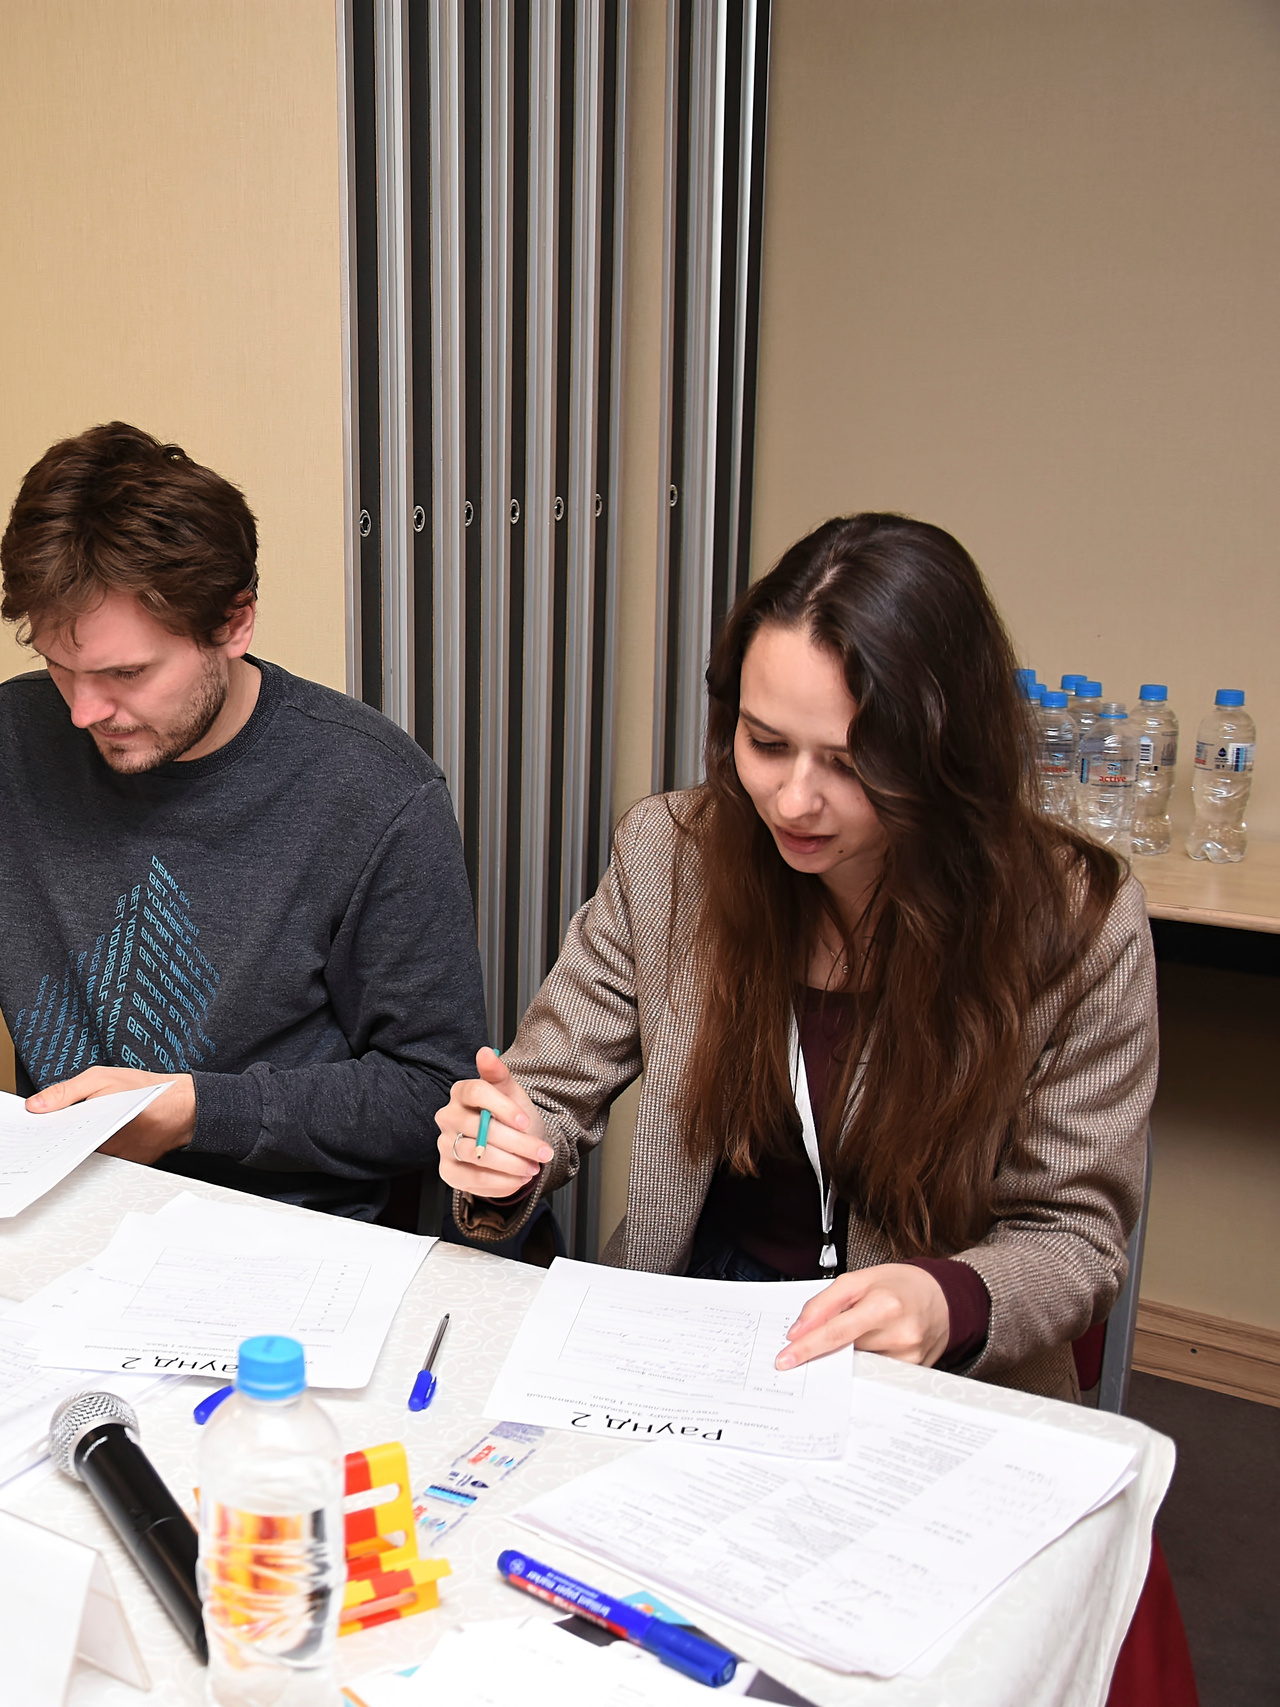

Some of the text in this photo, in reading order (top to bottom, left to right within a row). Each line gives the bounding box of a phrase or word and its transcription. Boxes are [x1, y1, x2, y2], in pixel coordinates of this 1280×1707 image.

[1099, 775, 1126, 783] active
[149, 872, 168, 897] GET
[152, 855, 179, 894] DEMIX
[115, 893, 126, 919] GET
[130, 884, 140, 911] GET
[146, 887, 192, 945] YOURSELF
[99, 923, 122, 1001] YOURSELF
[117, 914, 137, 993] YOURSELF
[139, 946, 158, 973] GET
[141, 926, 168, 965] SINCE
[143, 906, 174, 946] SPORT
[176, 944, 202, 980] STYLE
[136, 968, 168, 1008] SPORT
[127, 1015, 151, 1046] GET
[132, 991, 163, 1032] SINCE
[53, 1024, 77, 1076] MOVING
[70, 1027, 89, 1071] DEMIX
[121, 1355, 239, 1374] аунд 2
[570, 1411, 723, 1441] Раунд 2
